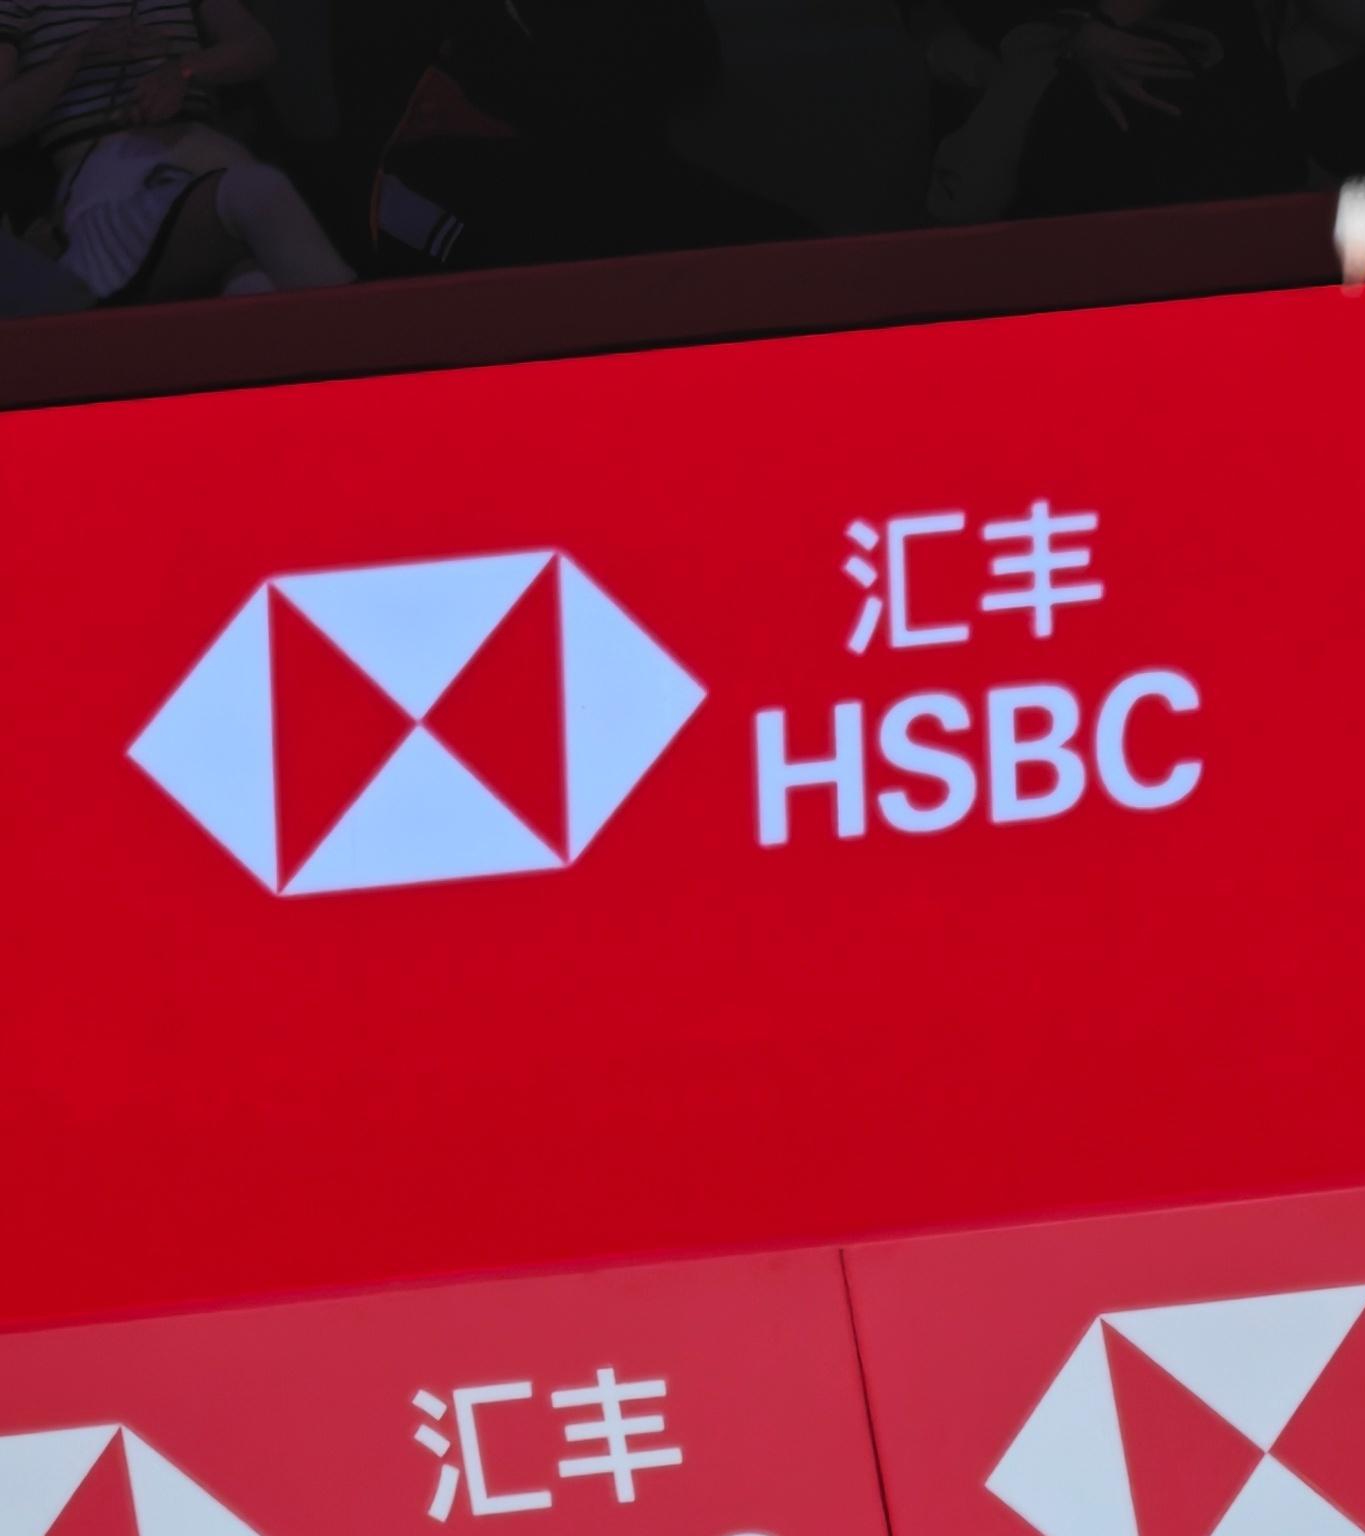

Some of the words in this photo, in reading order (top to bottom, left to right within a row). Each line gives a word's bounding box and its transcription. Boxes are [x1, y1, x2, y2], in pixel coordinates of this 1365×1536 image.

[844, 501, 1103, 654] 汇丰
[755, 669, 1202, 847] HSBC
[410, 1366, 684, 1523] 汇丰
